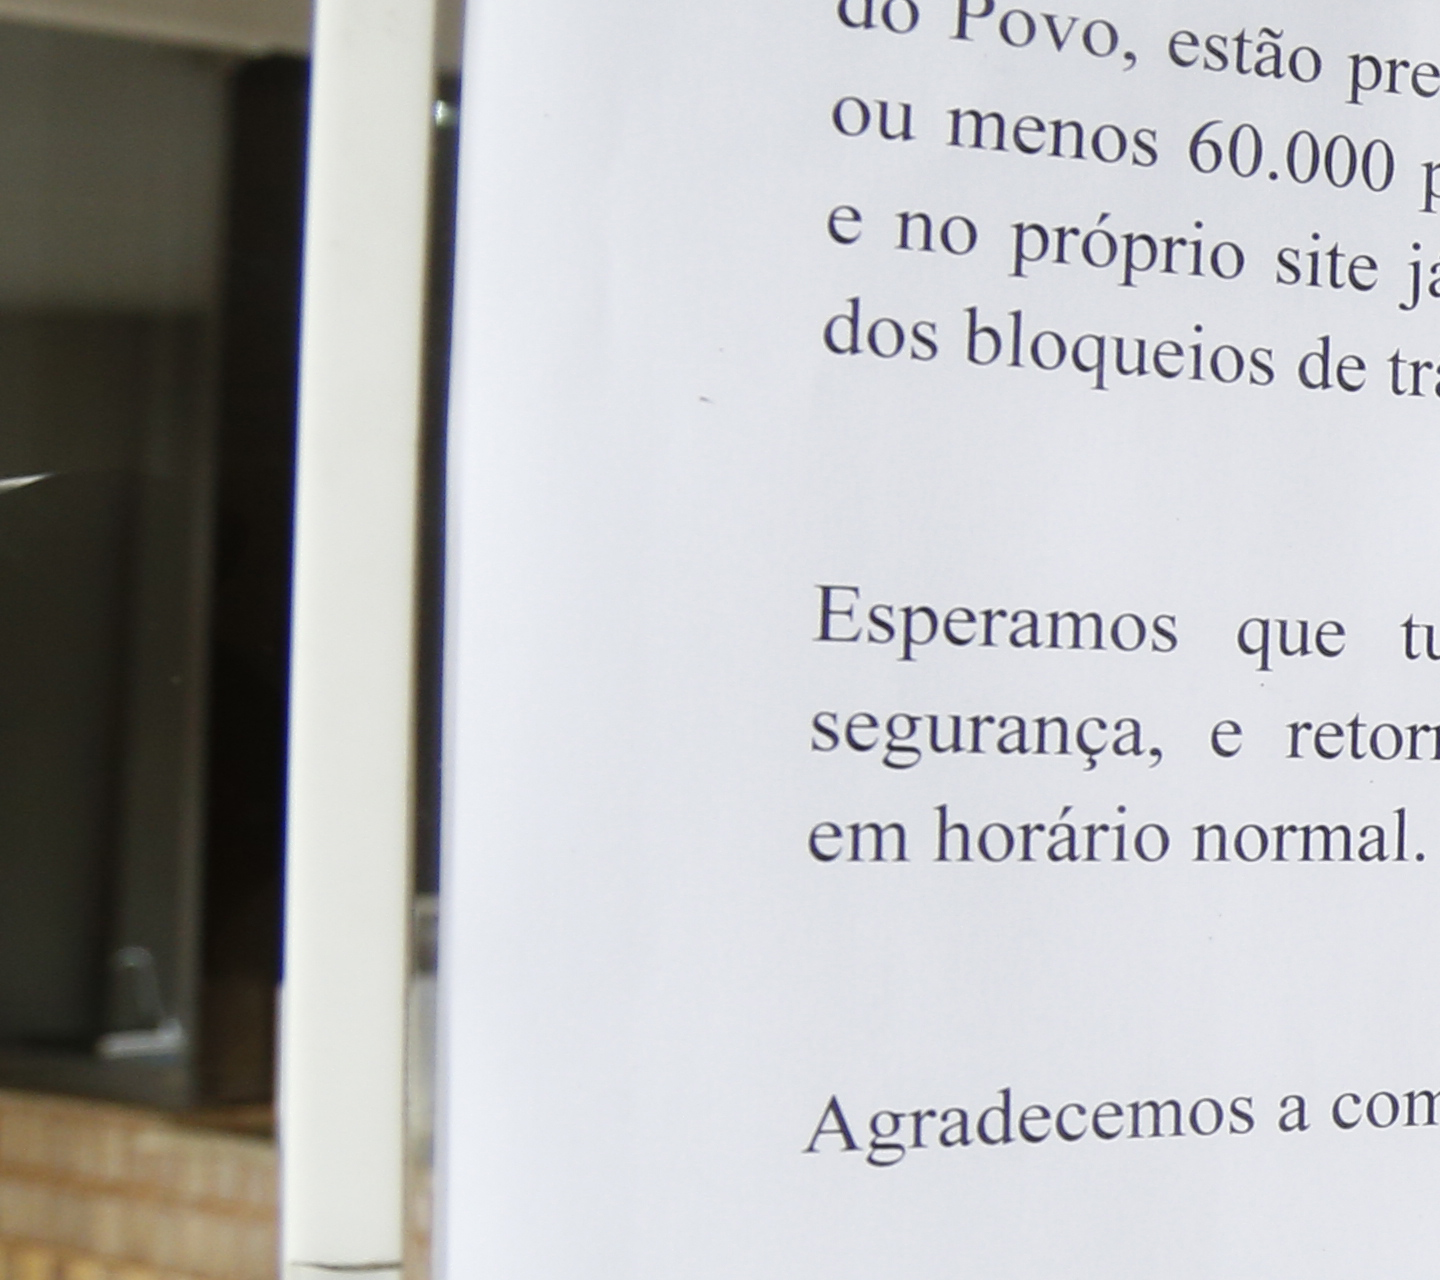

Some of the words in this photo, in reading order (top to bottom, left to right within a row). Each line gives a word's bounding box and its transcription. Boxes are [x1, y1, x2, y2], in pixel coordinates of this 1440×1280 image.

[1166, 24, 1324, 85] estão
[829, 94, 917, 143] ou
[945, 106, 1160, 169] menos
[1186, 117, 1396, 194] 60.000
[825, 203, 864, 247] e
[893, 209, 979, 257] no
[1006, 220, 1246, 289] próprio
[1274, 239, 1379, 293] site
[821, 294, 940, 363] dos
[962, 303, 1276, 392] bloqueios
[1295, 332, 1368, 394] de
[812, 582, 1179, 663] Esperamos
[1235, 615, 1347, 673] que
[809, 709, 1164, 773] segurança,
[1208, 717, 1244, 759] e
[806, 819, 910, 864] em
[932, 801, 1171, 864] horário
[1190, 804, 1429, 864] normal.
[800, 1084, 1256, 1169] Agradecemos
[1276, 1092, 1312, 1134] a
